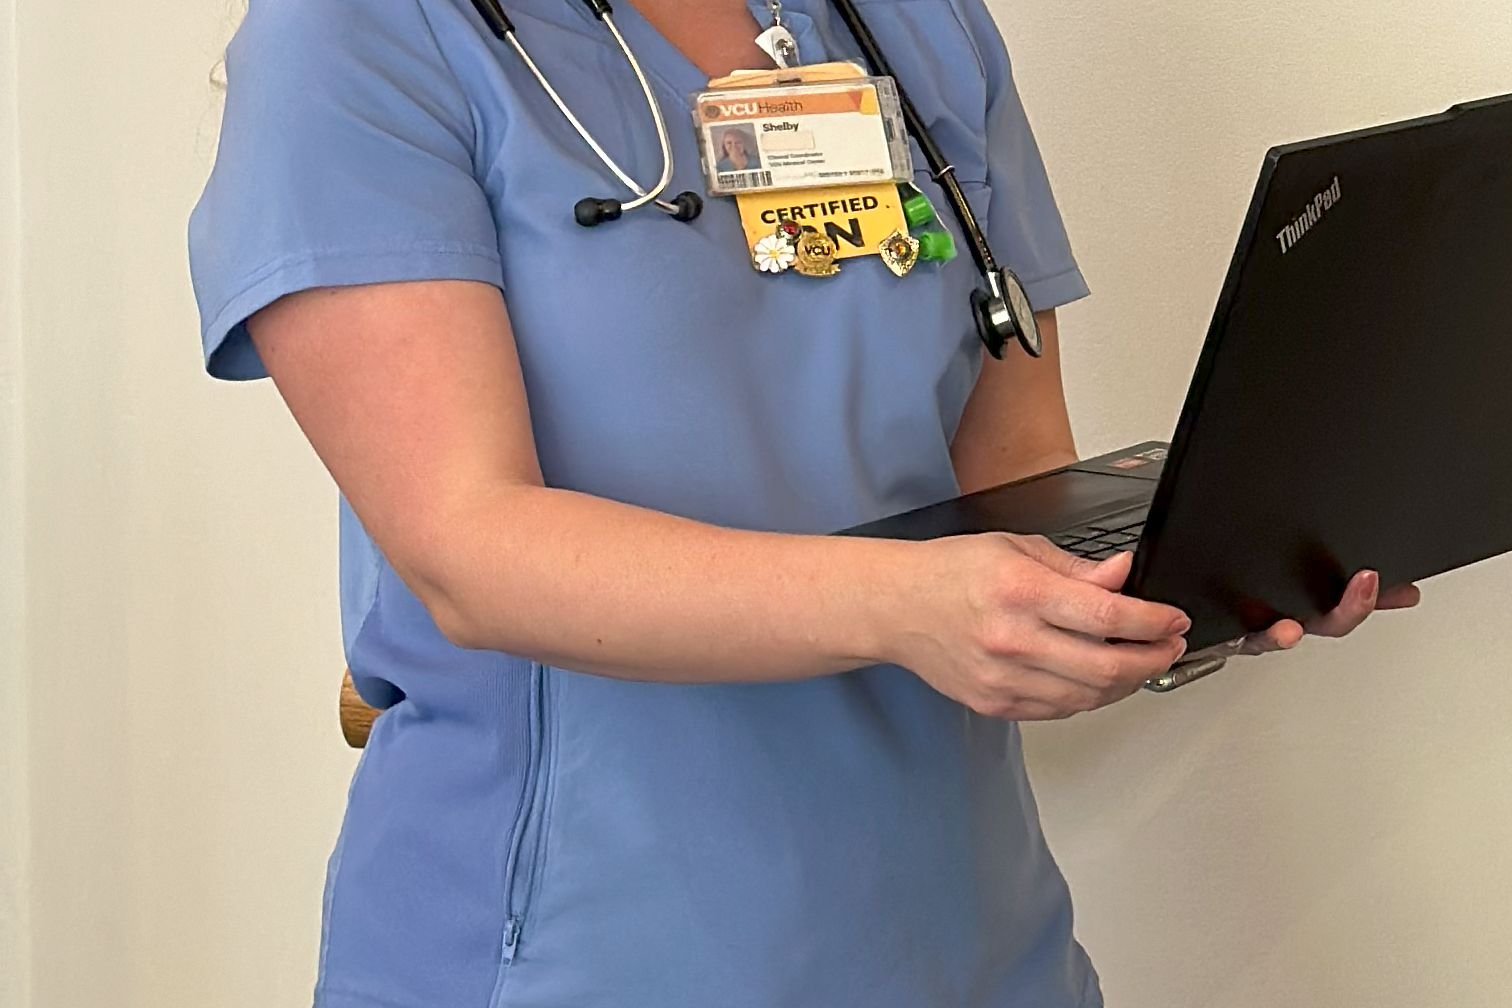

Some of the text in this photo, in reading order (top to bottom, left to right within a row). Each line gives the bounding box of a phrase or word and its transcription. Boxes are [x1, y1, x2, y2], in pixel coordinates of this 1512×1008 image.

[762, 121, 800, 132] Shelby
[760, 195, 879, 224] CERTIFIED
[1275, 175, 1342, 254] ThinkPad
[800, 218, 866, 252] N
[804, 244, 831, 256] VCU
